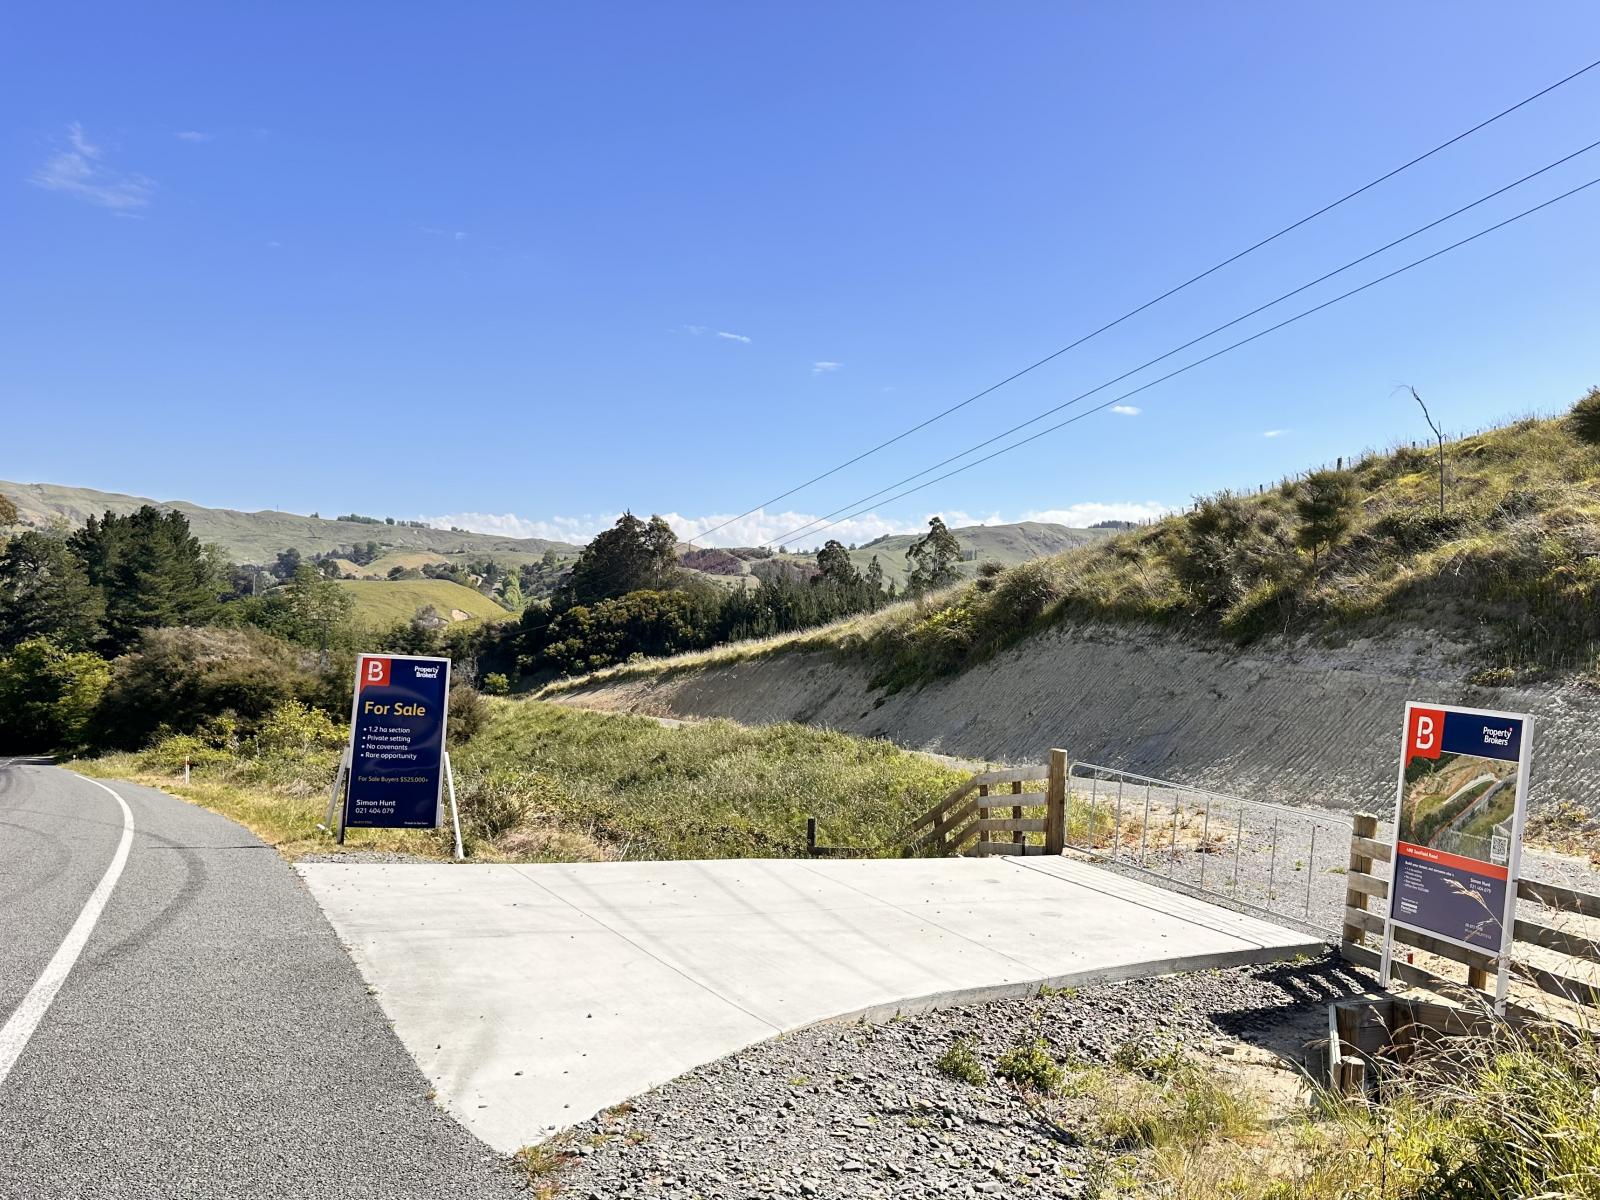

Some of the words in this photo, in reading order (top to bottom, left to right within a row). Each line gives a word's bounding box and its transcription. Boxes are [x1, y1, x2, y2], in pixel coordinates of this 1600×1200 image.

[367, 661, 383, 681] B
[414, 666, 439, 674] Property
[364, 701, 390, 715] For
[393, 702, 426, 716] Sale
[1415, 716, 1434, 750] B
[1483, 726, 1512, 739] Property
[1484, 735, 1508, 746] Brokers
